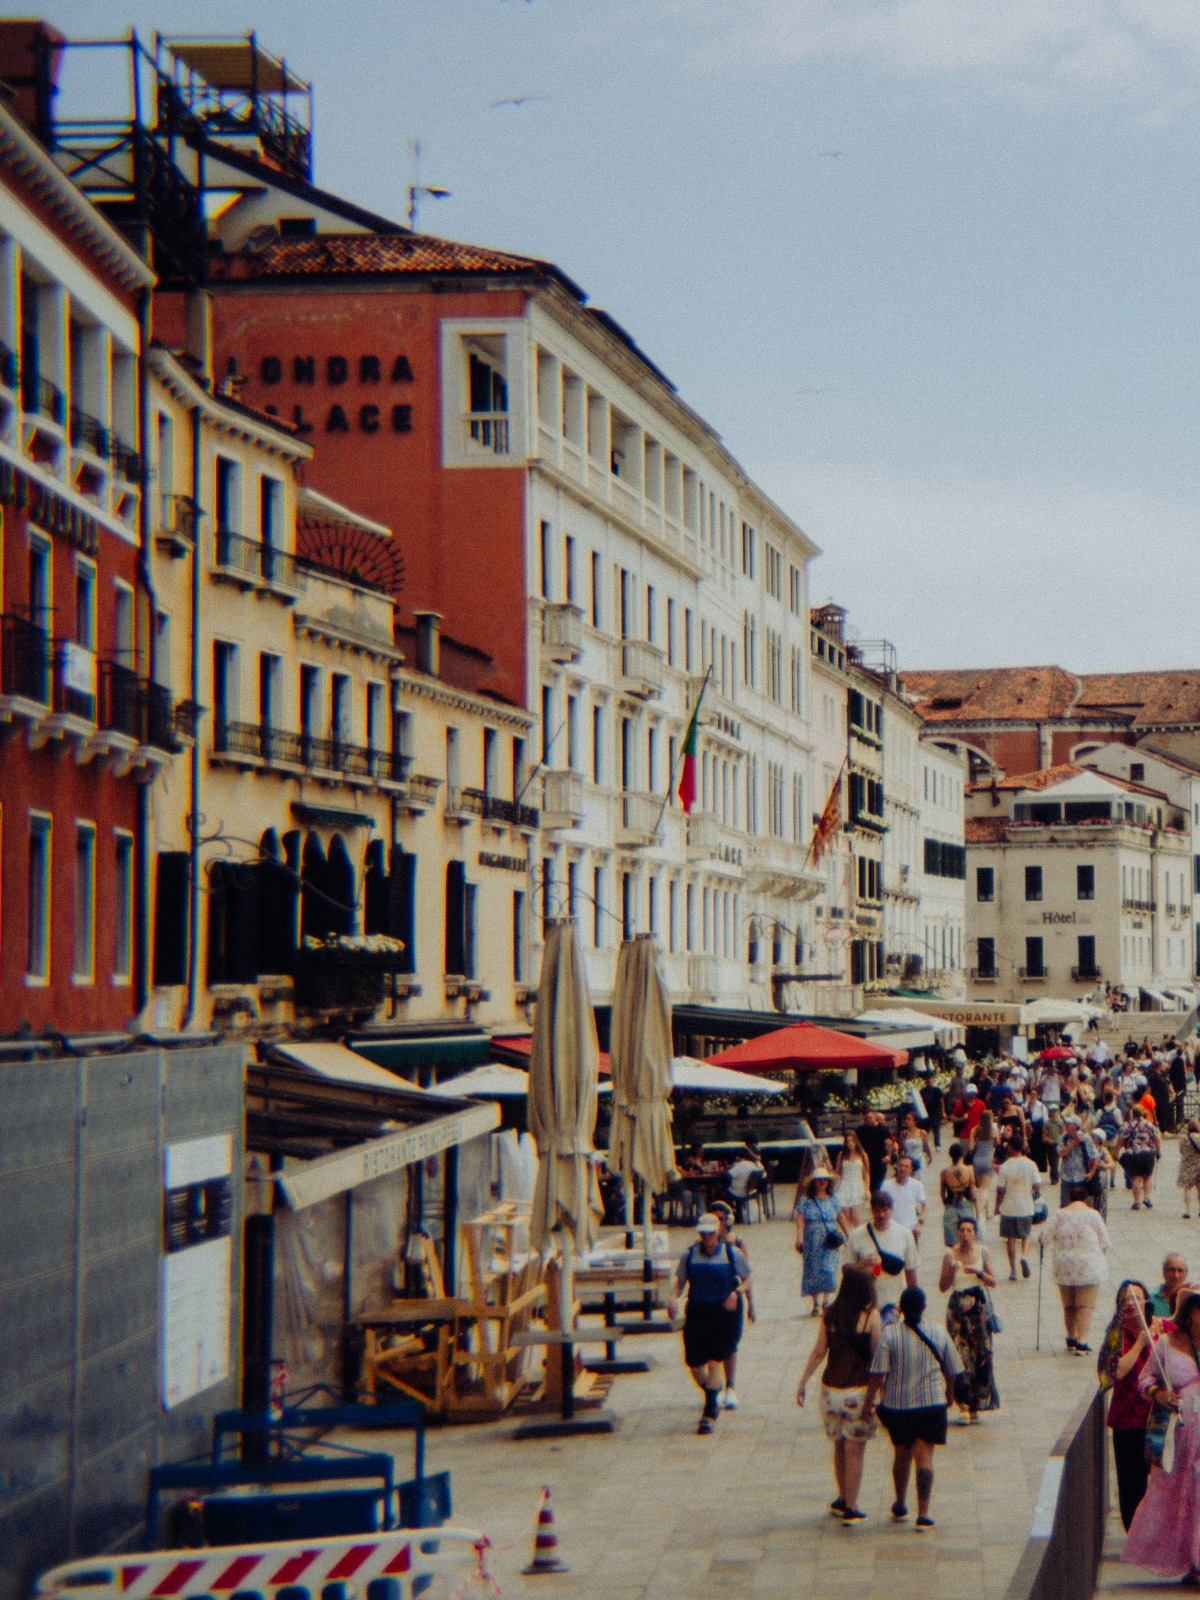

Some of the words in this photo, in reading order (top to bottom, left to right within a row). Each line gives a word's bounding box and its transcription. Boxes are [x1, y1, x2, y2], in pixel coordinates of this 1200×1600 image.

[227, 355, 414, 385] LONDRA
[264, 404, 413, 433] LACE
[1042, 912, 1077, 924] Hôtel
